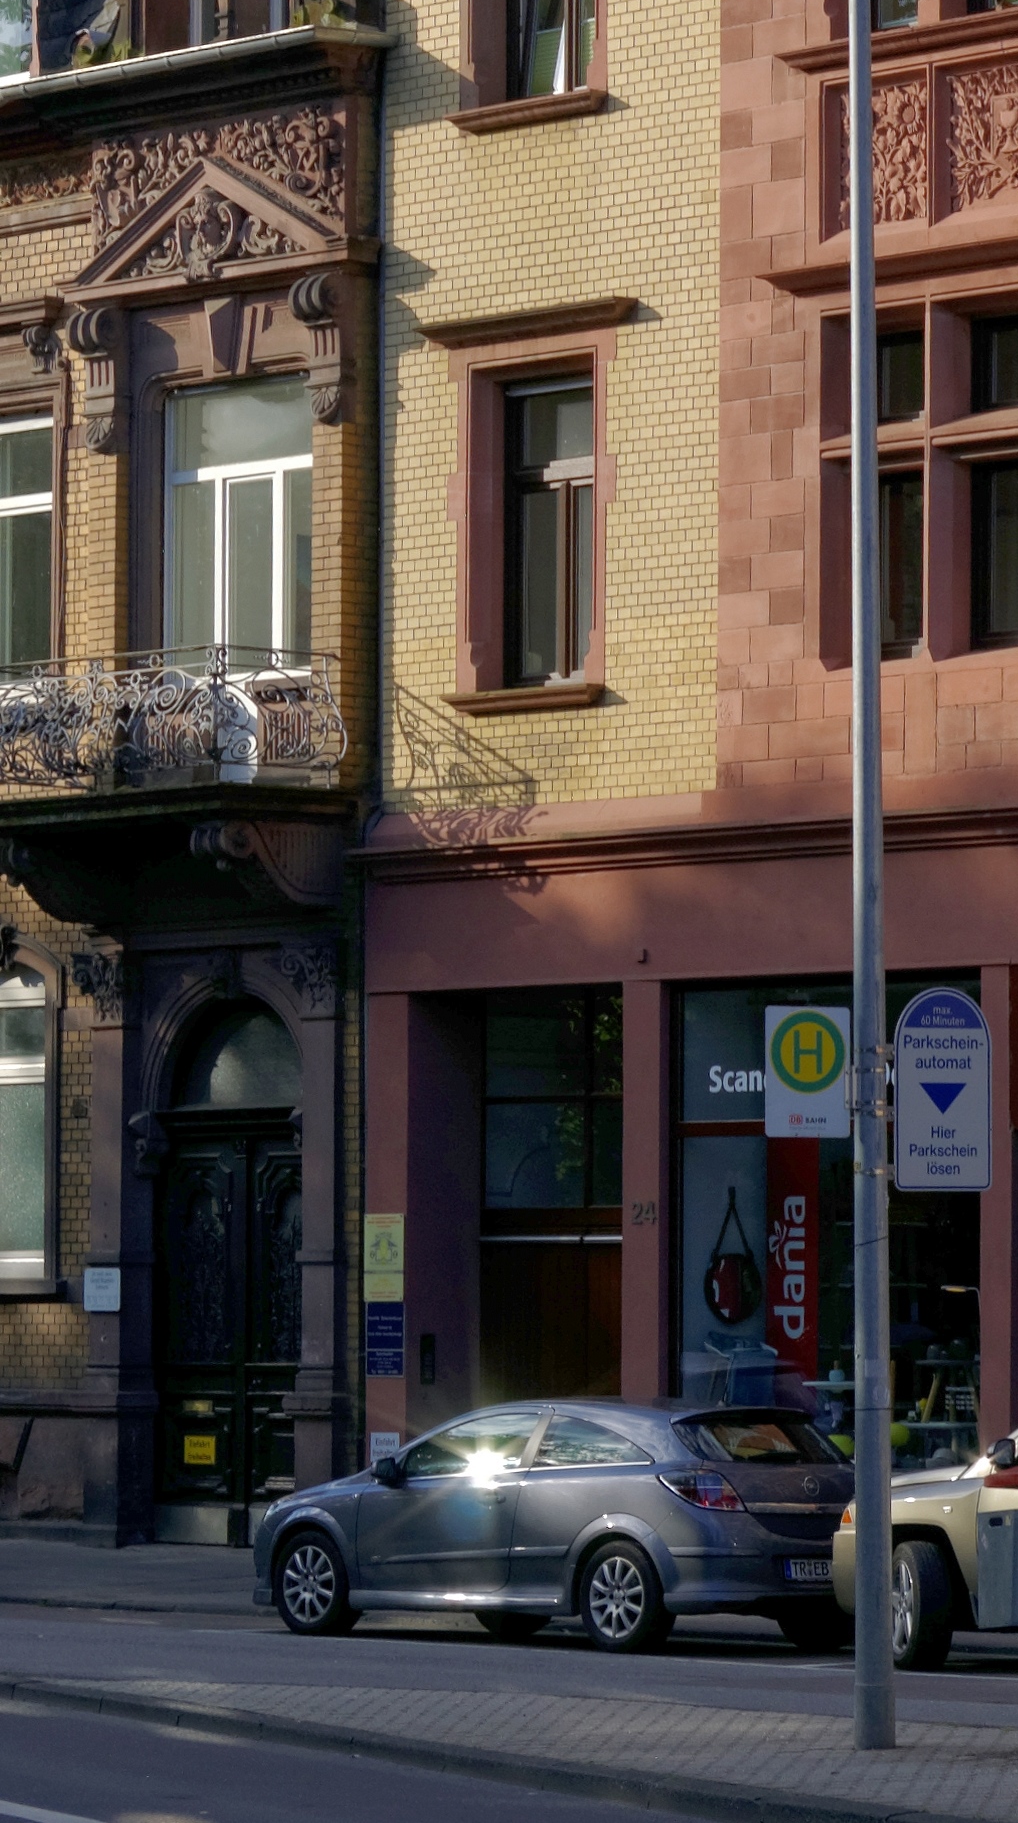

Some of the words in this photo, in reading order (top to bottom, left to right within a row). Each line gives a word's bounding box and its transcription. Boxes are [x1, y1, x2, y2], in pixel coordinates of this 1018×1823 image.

[932, 1006, 953, 1014] max.
[920, 1015, 931, 1026] 60
[932, 1015, 966, 1027] Minuten
[903, 1034, 984, 1050] Parkschein-
[793, 1030, 823, 1075] H
[914, 1056, 972, 1070] automat
[708, 1064, 766, 1094] Scan
[930, 1126, 957, 1140] Hier
[909, 1143, 978, 1158] Parkschein
[926, 1161, 961, 1176] lösen
[631, 1200, 657, 1225] 24
[774, 1195, 806, 1340] dania
[791, 1561, 807, 1577] TR
[813, 1561, 830, 1576] EB
